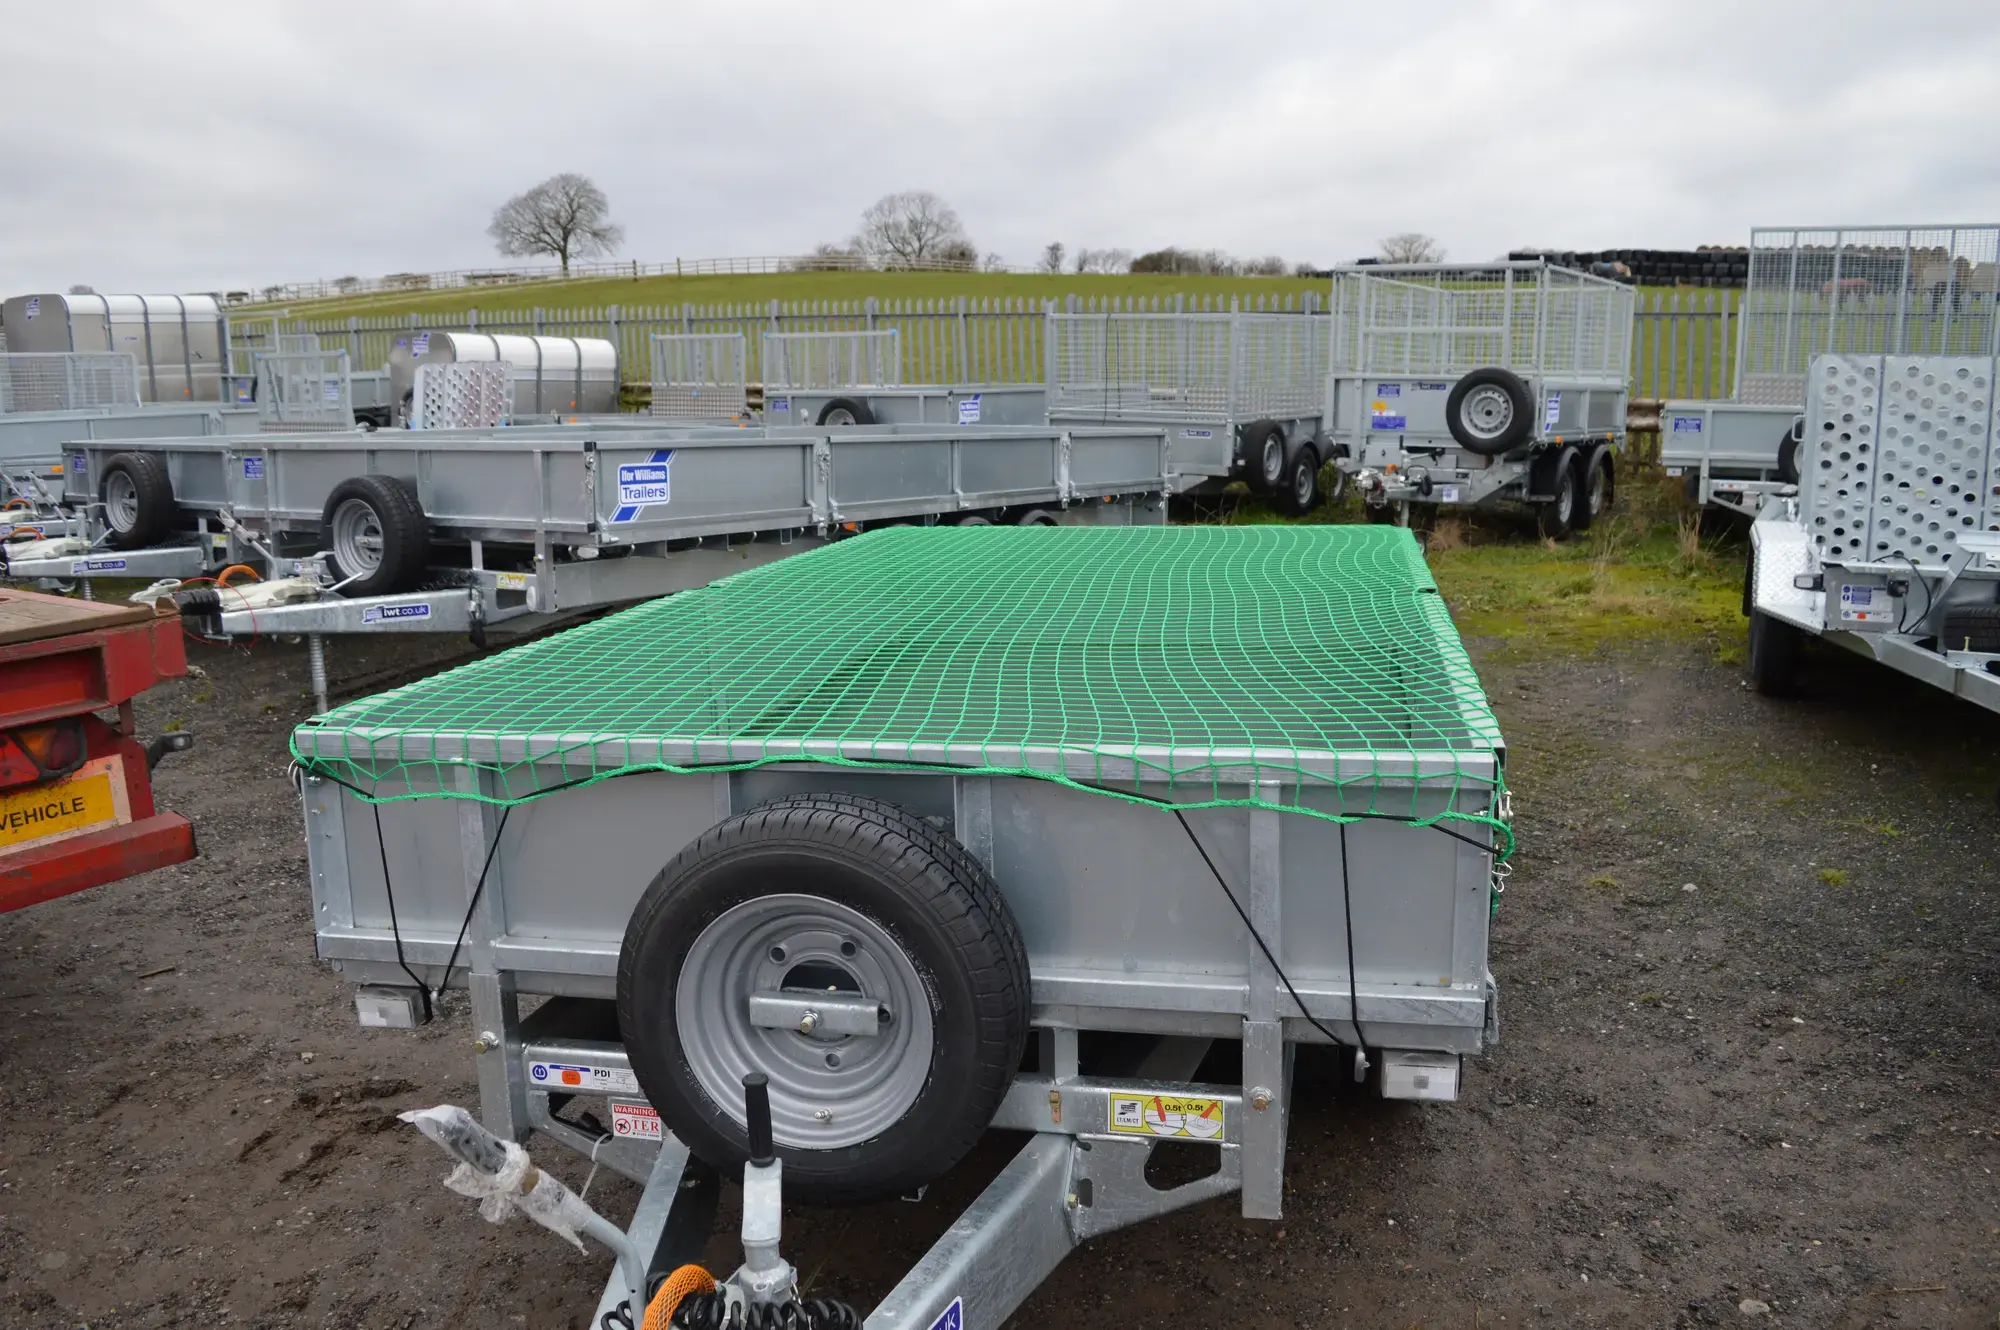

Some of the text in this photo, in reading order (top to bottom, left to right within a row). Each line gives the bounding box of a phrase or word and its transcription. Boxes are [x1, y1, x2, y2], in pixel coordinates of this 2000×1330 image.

[621, 468, 666, 482] Ifor Williams
[622, 486, 666, 500] Trailers
[0, 796, 86, 831] VEHICLE
[594, 1069, 611, 1078] PDI
[614, 1105, 657, 1117] WARNING!
[1164, 1103, 1204, 1112] 0.5t 0.5t
[631, 1119, 660, 1132] TER
